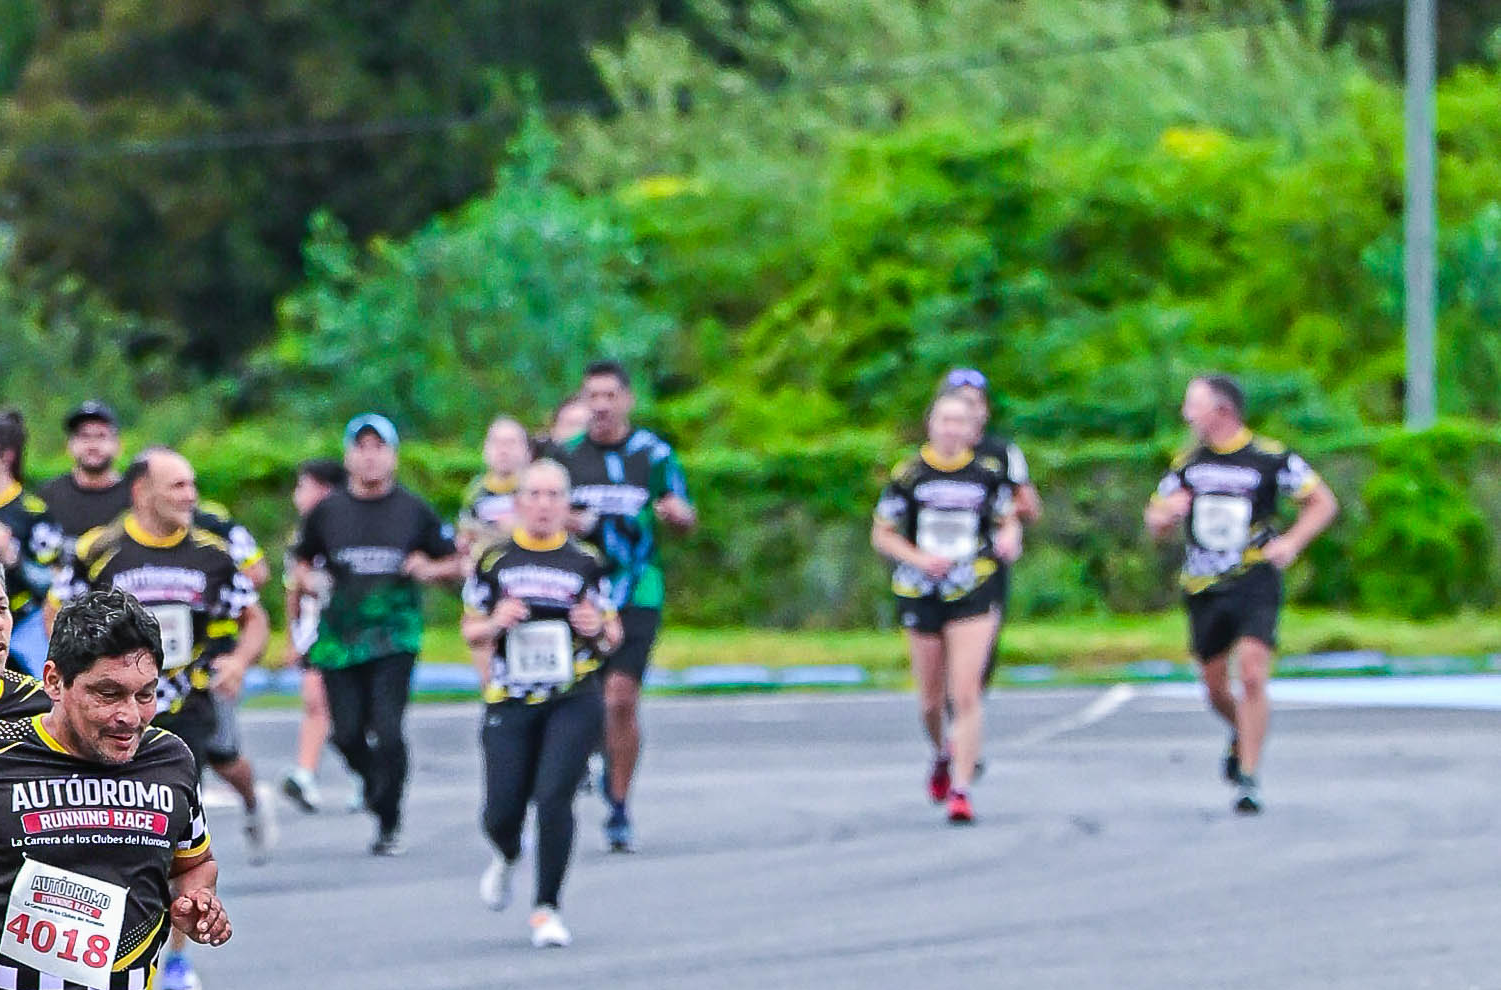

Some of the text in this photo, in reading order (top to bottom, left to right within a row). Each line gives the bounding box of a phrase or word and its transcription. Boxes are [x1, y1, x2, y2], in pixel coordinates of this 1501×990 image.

[11, 773, 175, 813] AUTÓDROMO
[39, 810, 155, 831] RUNNING RACE
[11, 837, 23, 847] La
[24, 836, 61, 846] Carrera
[62, 834, 75, 844] de
[76, 833, 91, 844] los
[91, 833, 124, 844] Clubes
[124, 834, 140, 845] del
[30, 876, 112, 910] AUTÓDROMO
[5, 912, 111, 969] 4018
